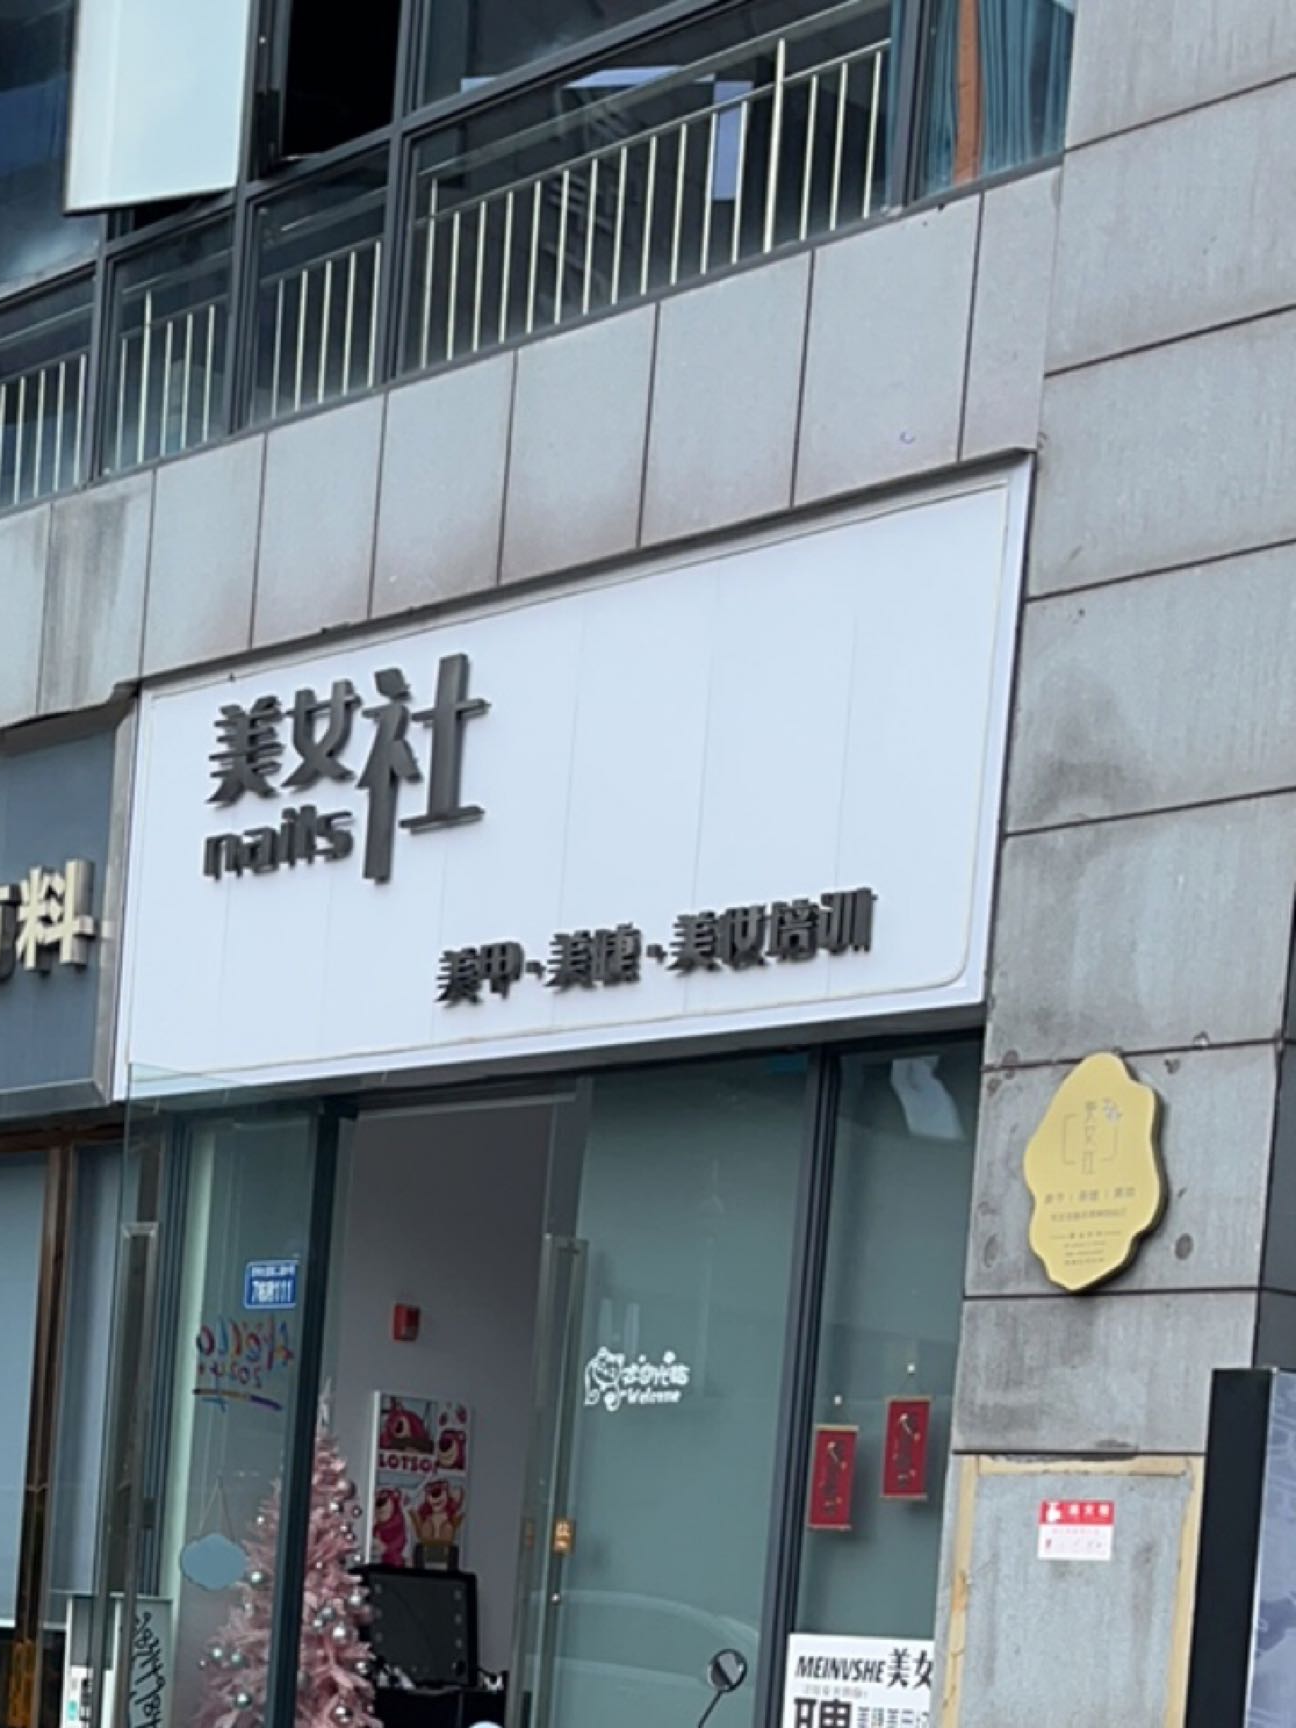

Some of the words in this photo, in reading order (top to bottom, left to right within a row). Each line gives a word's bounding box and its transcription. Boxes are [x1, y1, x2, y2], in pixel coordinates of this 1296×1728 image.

[206, 652, 490, 885] 美女社
[203, 805, 355, 882] nails
[795, 1655, 886, 1684] MEINVSHE
